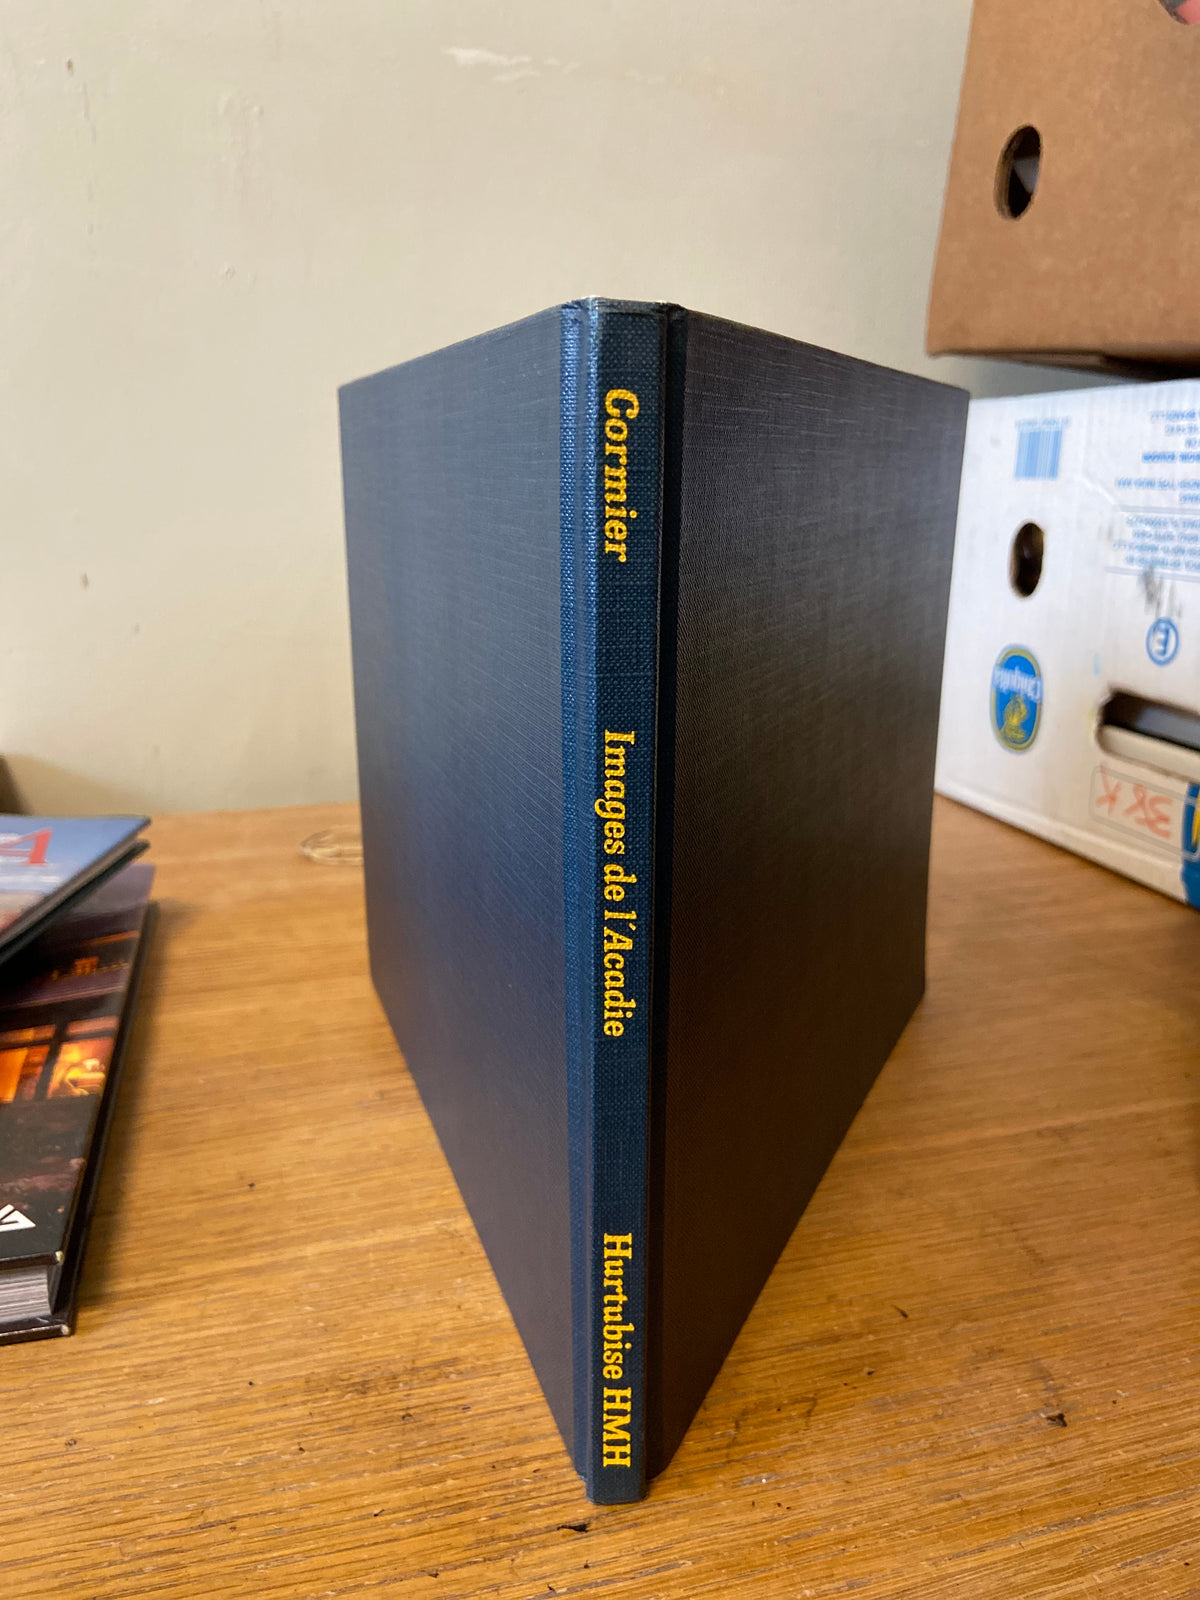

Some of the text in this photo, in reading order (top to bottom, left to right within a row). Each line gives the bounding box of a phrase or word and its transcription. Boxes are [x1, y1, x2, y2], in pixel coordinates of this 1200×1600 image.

[604, 388, 640, 563] Cormier
[594, 729, 638, 1037] Images de l'Acadie
[602, 1232, 635, 1468] Hurtubise HMH
